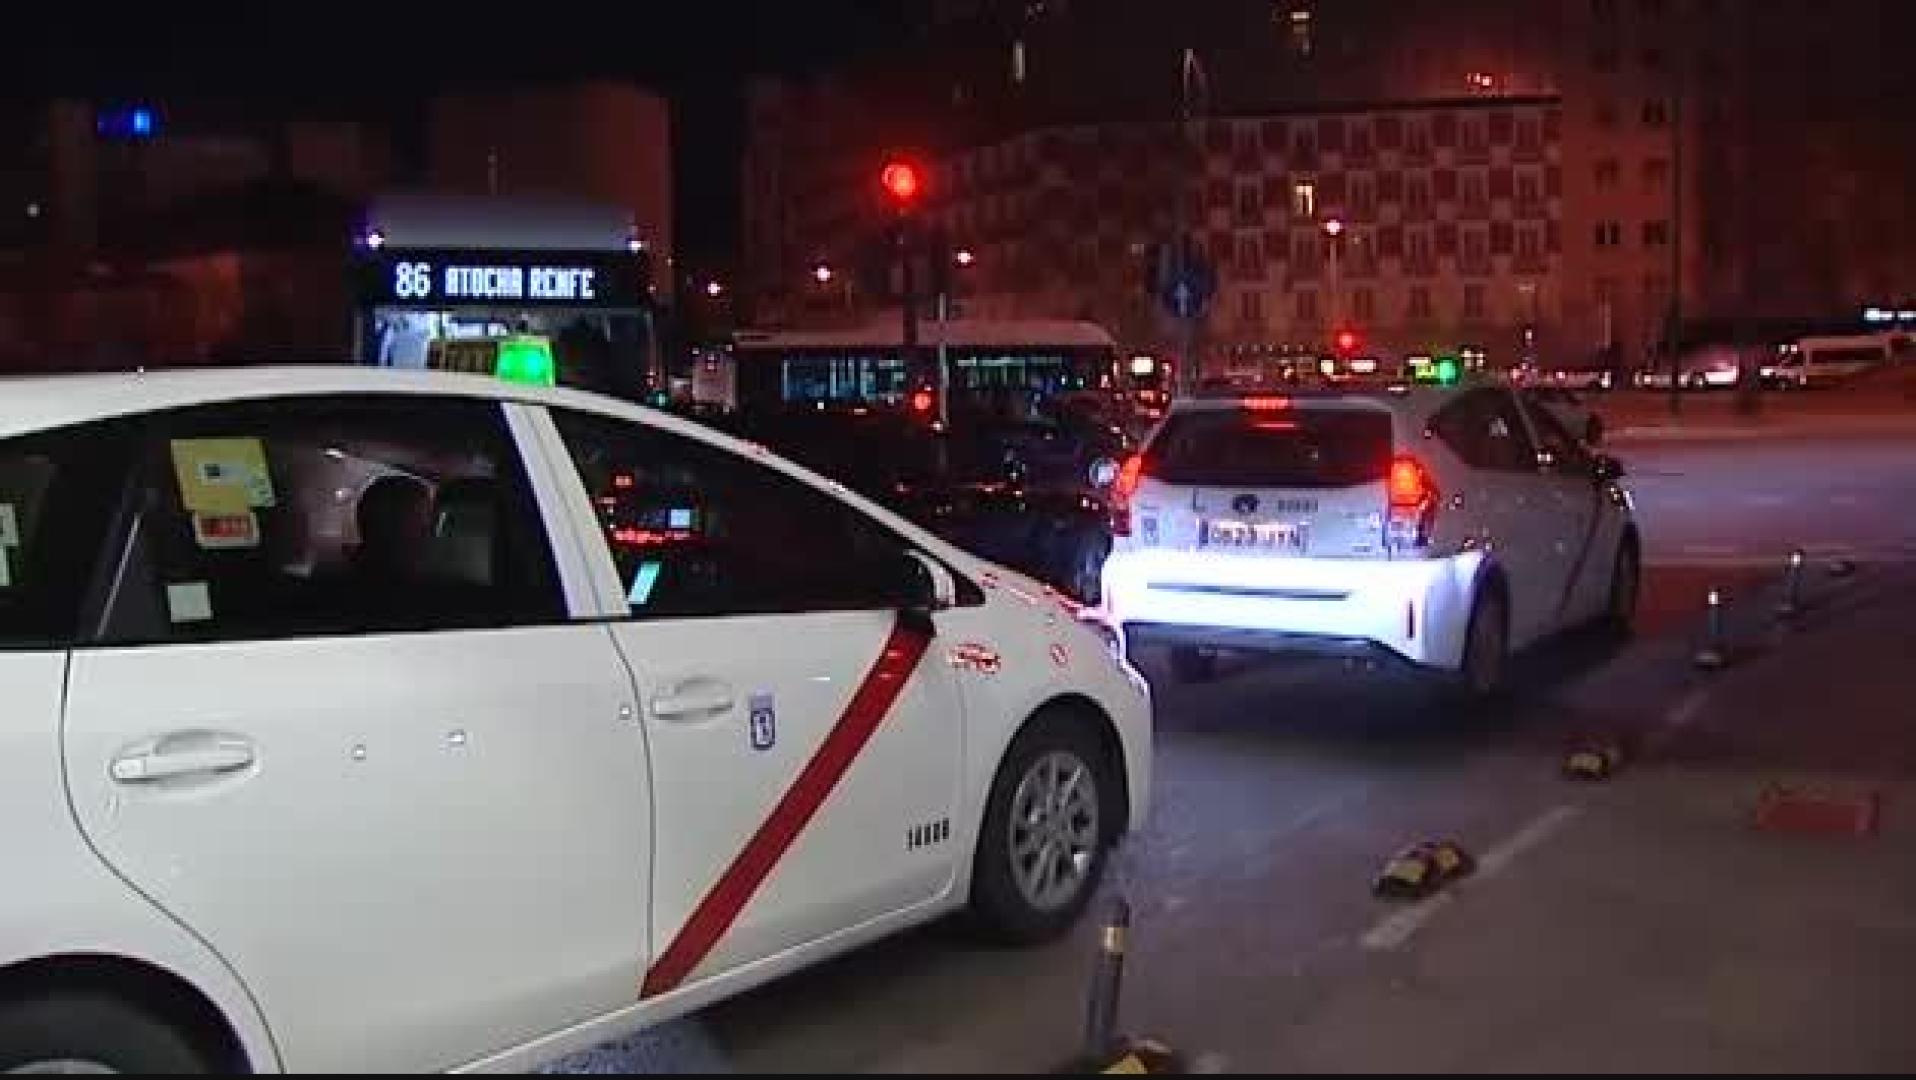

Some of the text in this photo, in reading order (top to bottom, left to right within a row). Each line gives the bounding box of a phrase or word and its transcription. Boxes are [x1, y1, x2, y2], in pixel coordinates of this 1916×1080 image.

[396, 262, 595, 299] 86 ATOCHA RENFE
